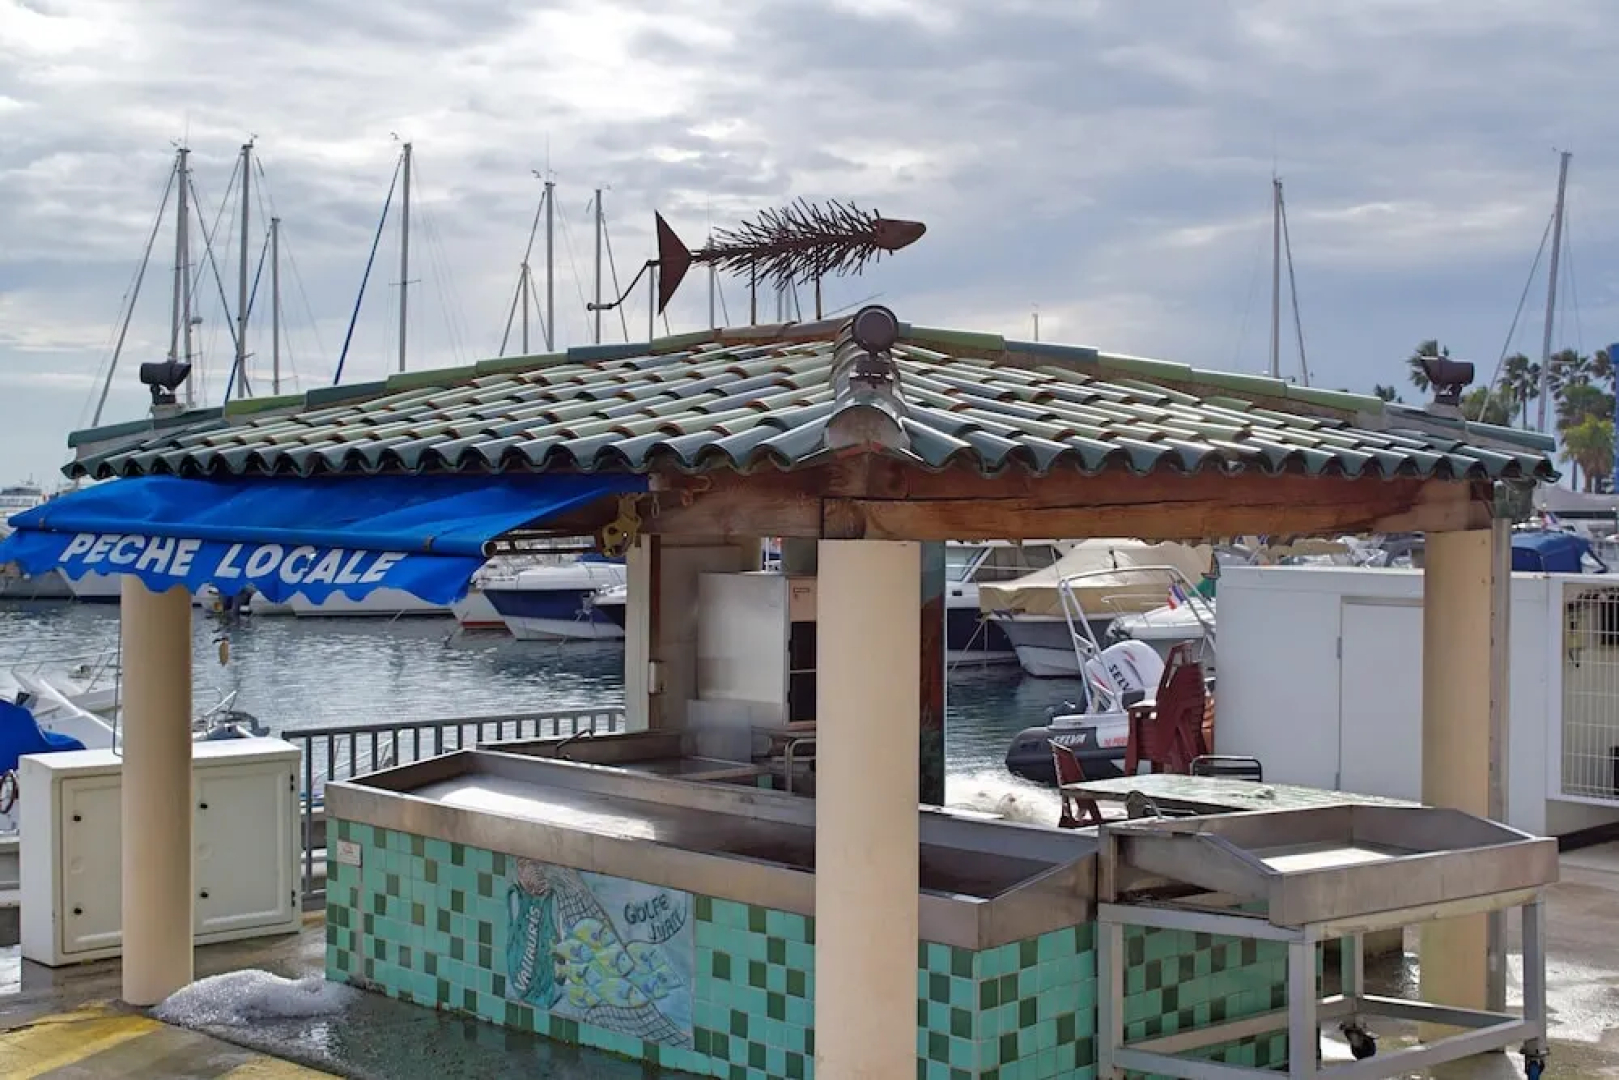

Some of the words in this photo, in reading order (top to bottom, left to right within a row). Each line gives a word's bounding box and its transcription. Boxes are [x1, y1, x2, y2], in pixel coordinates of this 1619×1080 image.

[58, 533, 203, 577] PECHE
[215, 543, 407, 585] LOCALE
[1108, 664, 1134, 692] SELV
